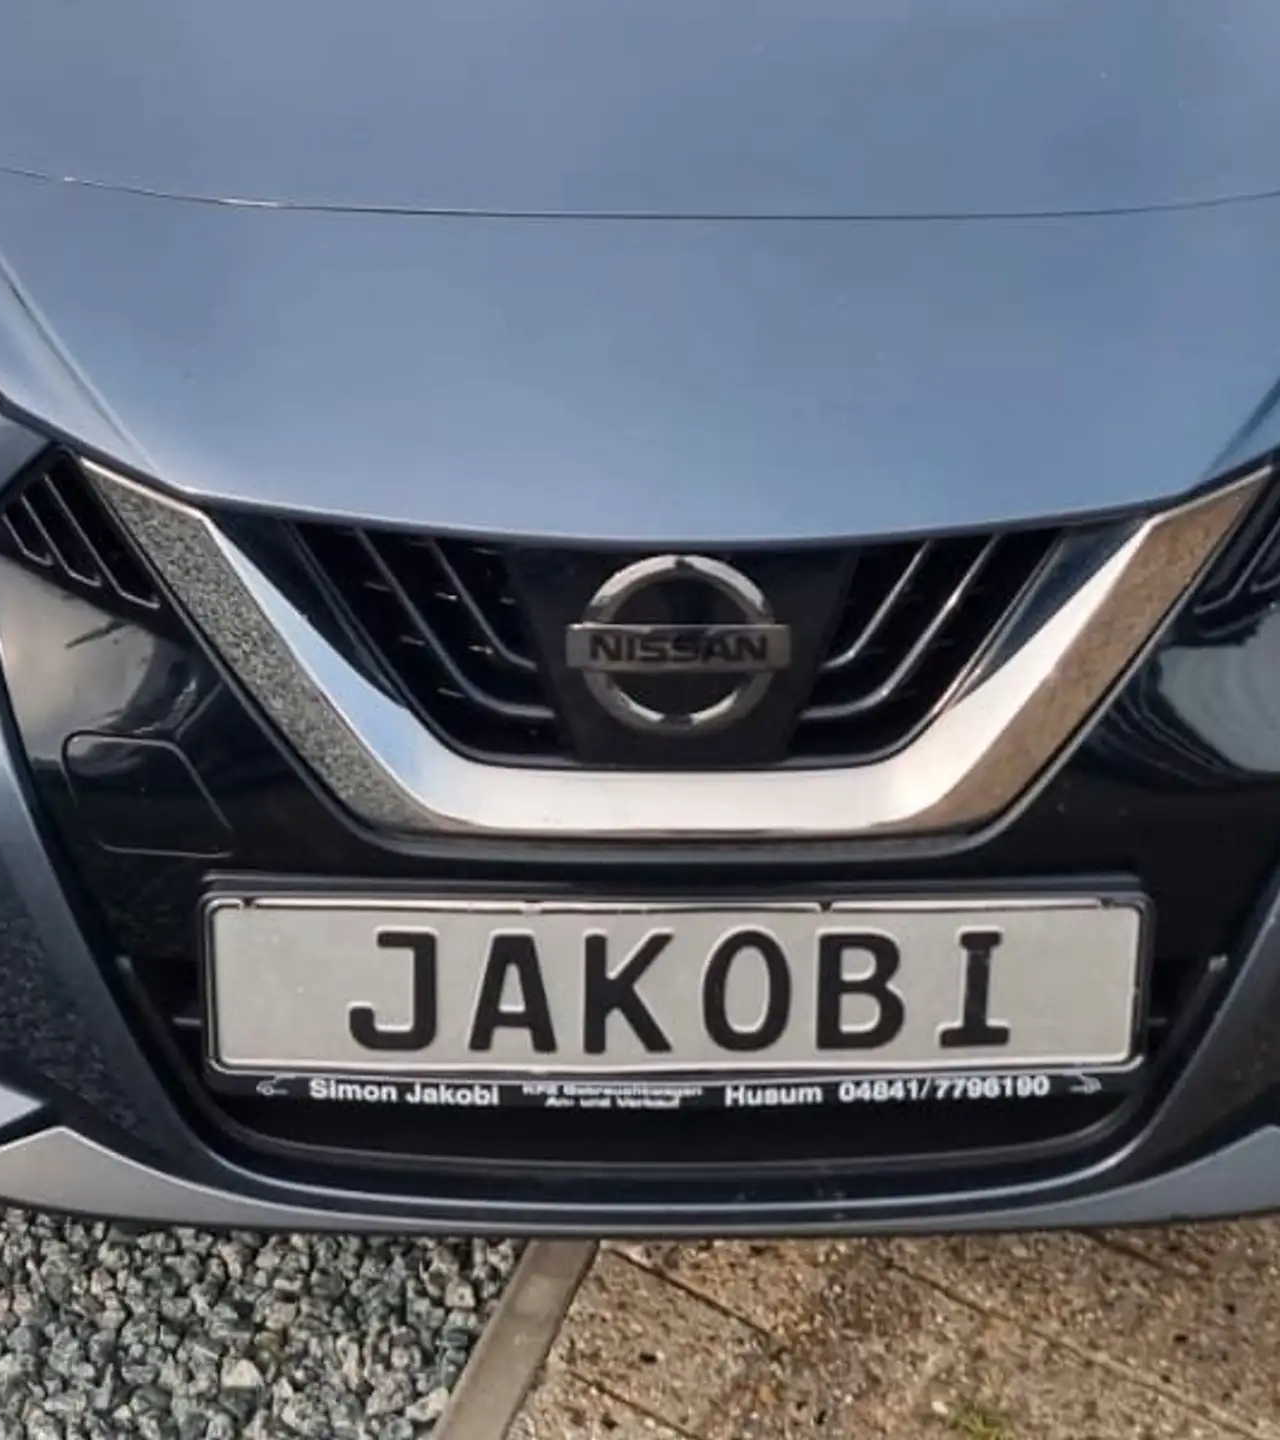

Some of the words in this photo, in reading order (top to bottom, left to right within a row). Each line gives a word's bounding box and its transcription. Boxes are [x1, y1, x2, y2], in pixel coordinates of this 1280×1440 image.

[590, 632, 768, 661] NISSAN
[349, 928, 1010, 1053] JAKOBI
[309, 1077, 398, 1103] Simon
[405, 1082, 500, 1106] Jakobi
[725, 1082, 822, 1107] Husum
